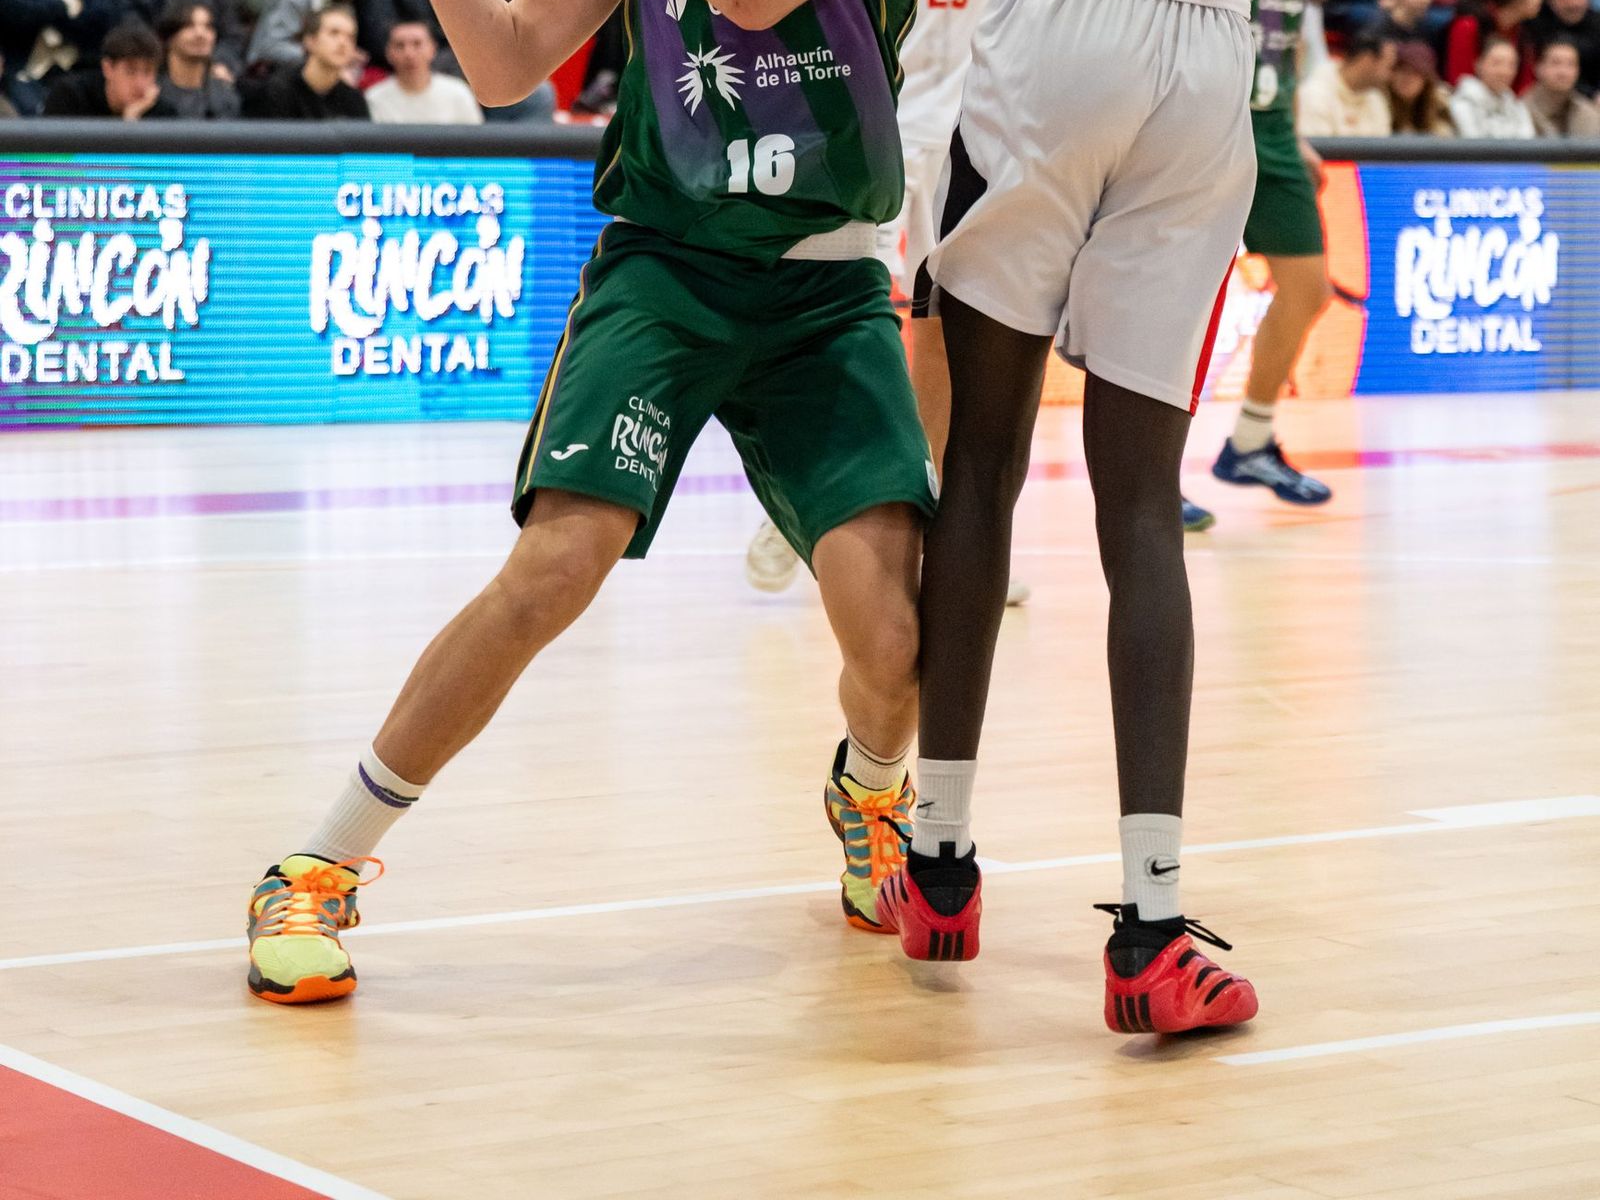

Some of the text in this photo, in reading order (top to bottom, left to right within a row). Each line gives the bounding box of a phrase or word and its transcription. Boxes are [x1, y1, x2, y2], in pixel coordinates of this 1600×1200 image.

[754, 46, 834, 71] Alhaurín
[756, 64, 852, 88] de la Torre
[726, 133, 796, 196] 16
[4, 183, 189, 219] CLINICAS
[336, 182, 505, 217] CLINICAS
[1414, 187, 1545, 218] CLINICAS
[1411, 315, 1543, 354] DENTAL
[0, 341, 186, 383] DENTAL
